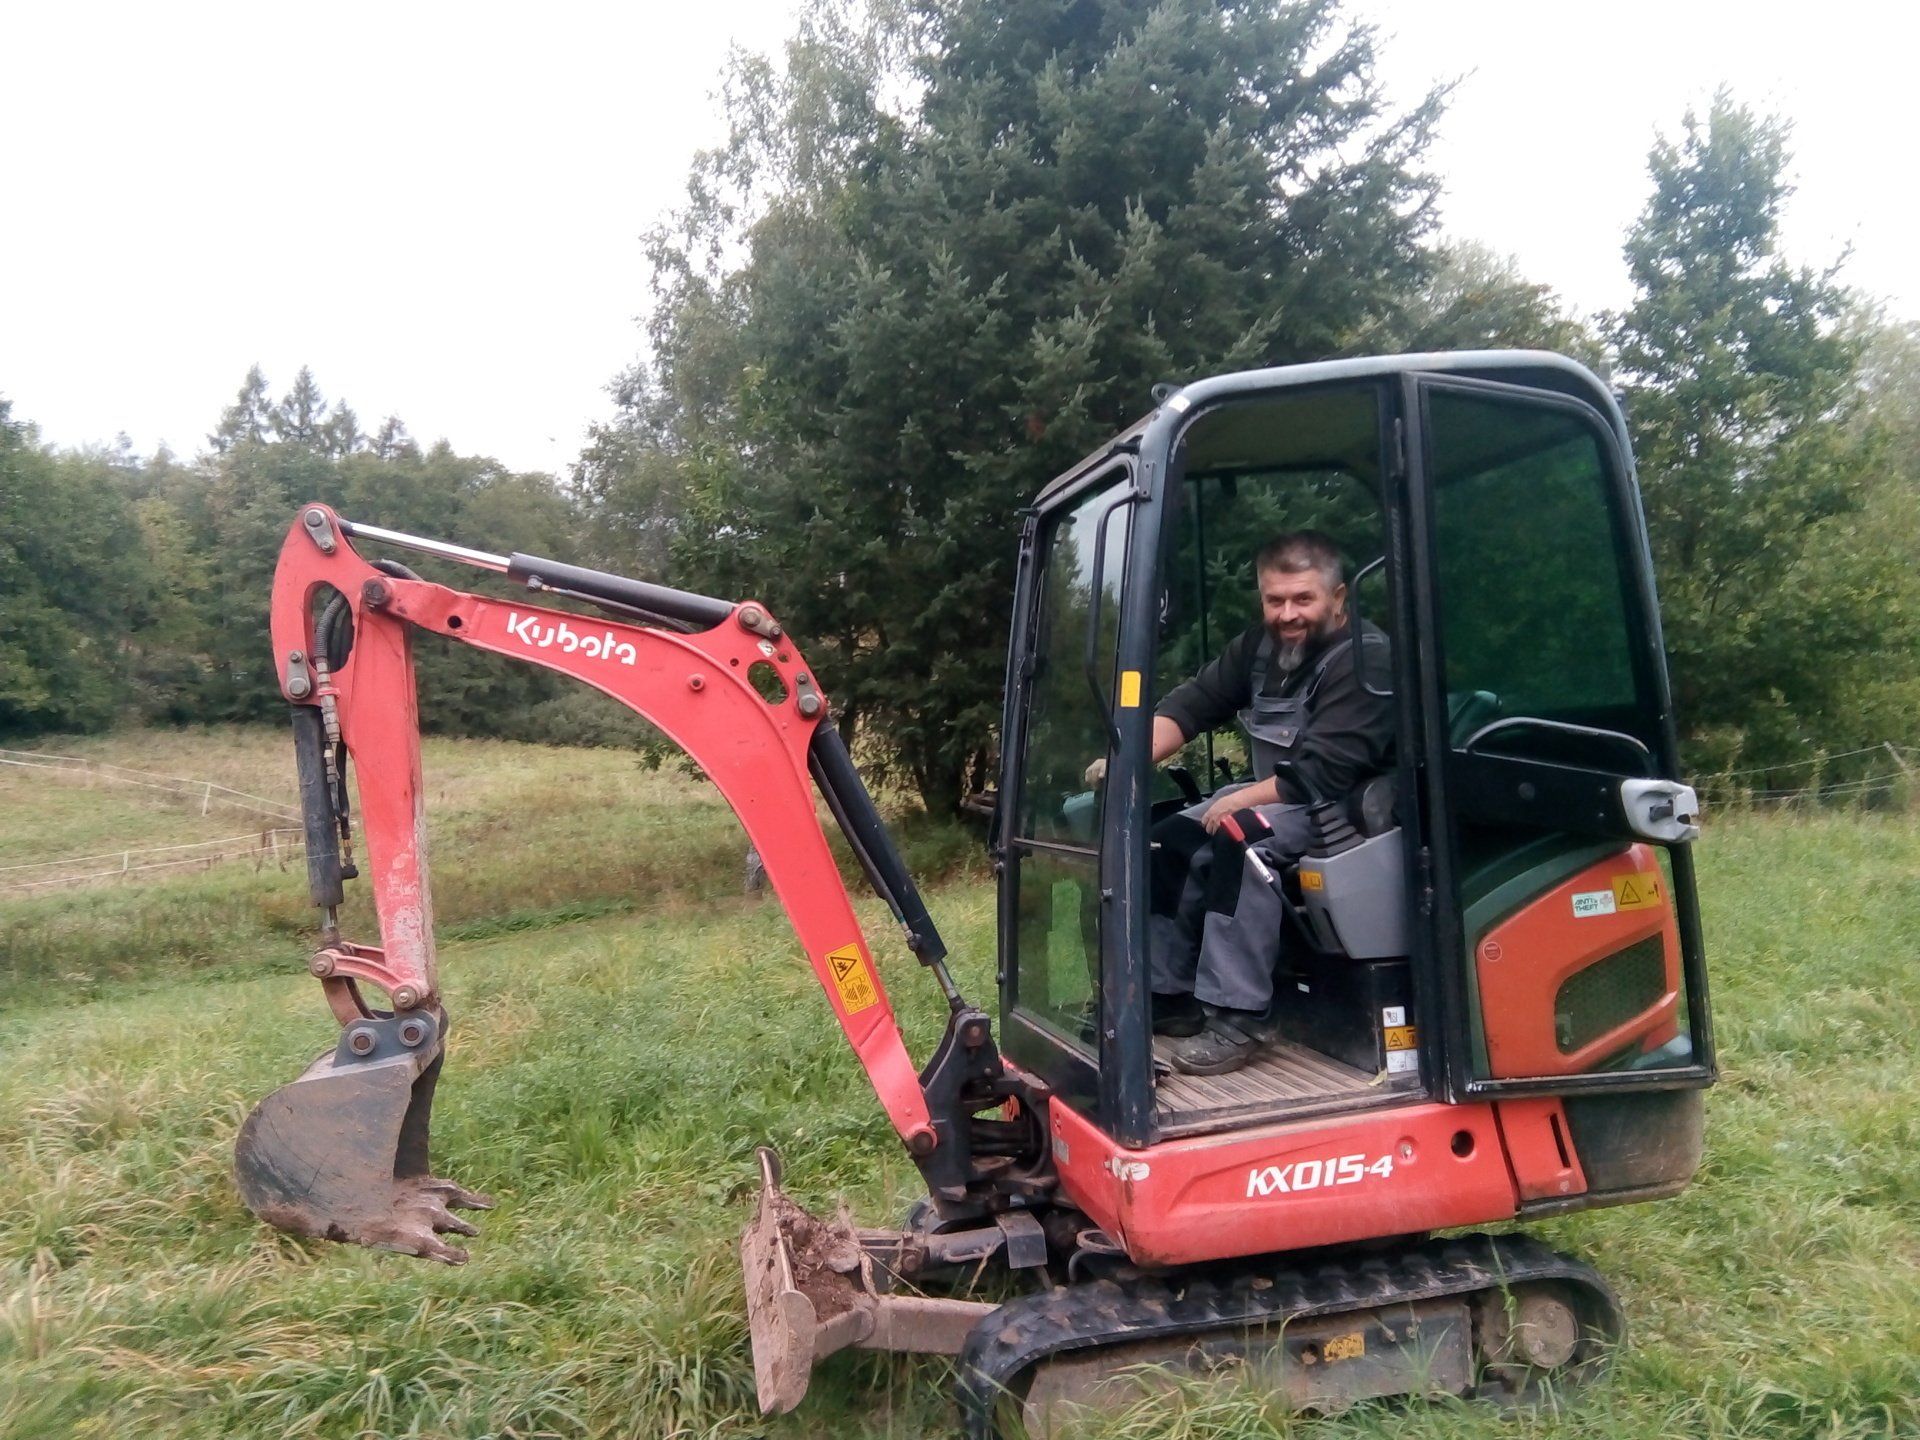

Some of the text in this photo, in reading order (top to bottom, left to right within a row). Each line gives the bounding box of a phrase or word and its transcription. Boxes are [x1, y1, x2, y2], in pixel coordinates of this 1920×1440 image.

[506, 612, 637, 666] Kubota
[1575, 903, 1598, 911] THEFT
[1246, 1153, 1394, 1198] KX015-4
